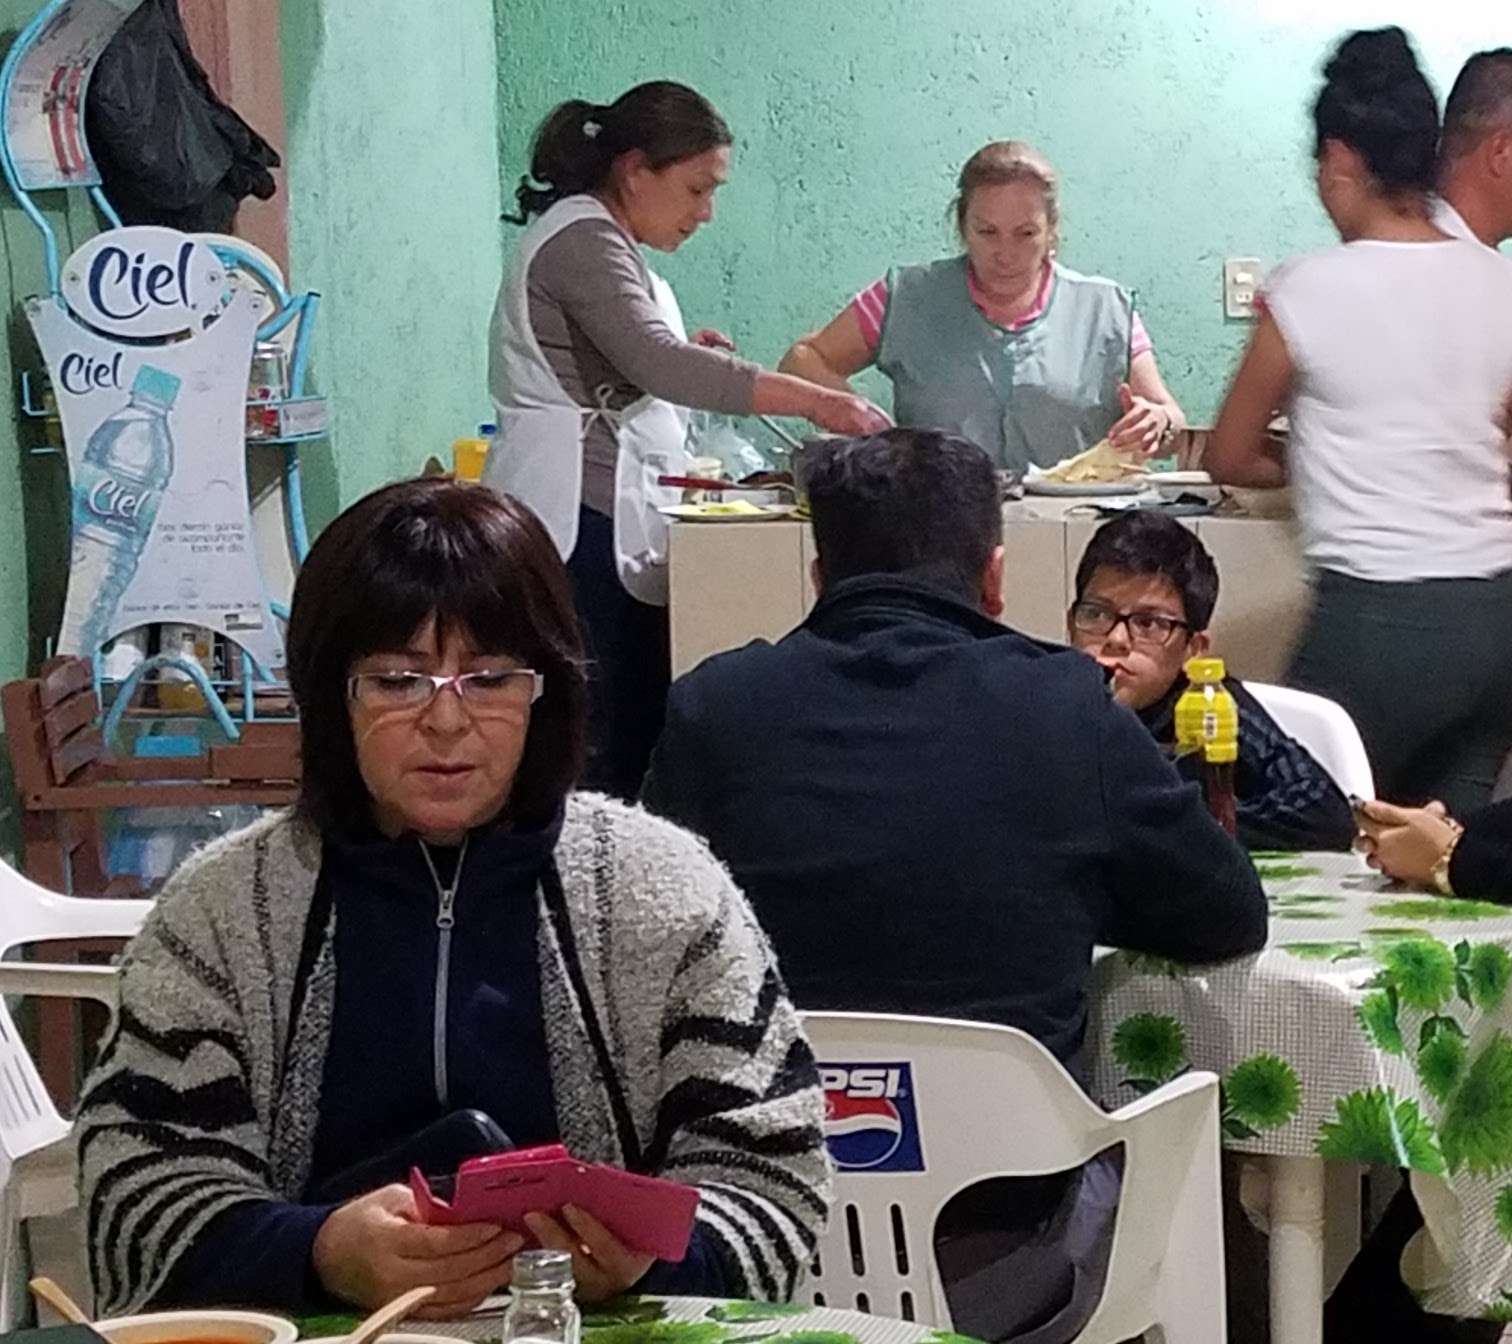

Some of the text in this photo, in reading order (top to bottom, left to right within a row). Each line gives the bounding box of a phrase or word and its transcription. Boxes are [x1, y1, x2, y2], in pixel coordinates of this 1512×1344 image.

[88, 242, 196, 320] Ciel
[60, 352, 123, 395] Ciel
[89, 478, 151, 519] Ciel
[819, 1069, 901, 1098] PSI
